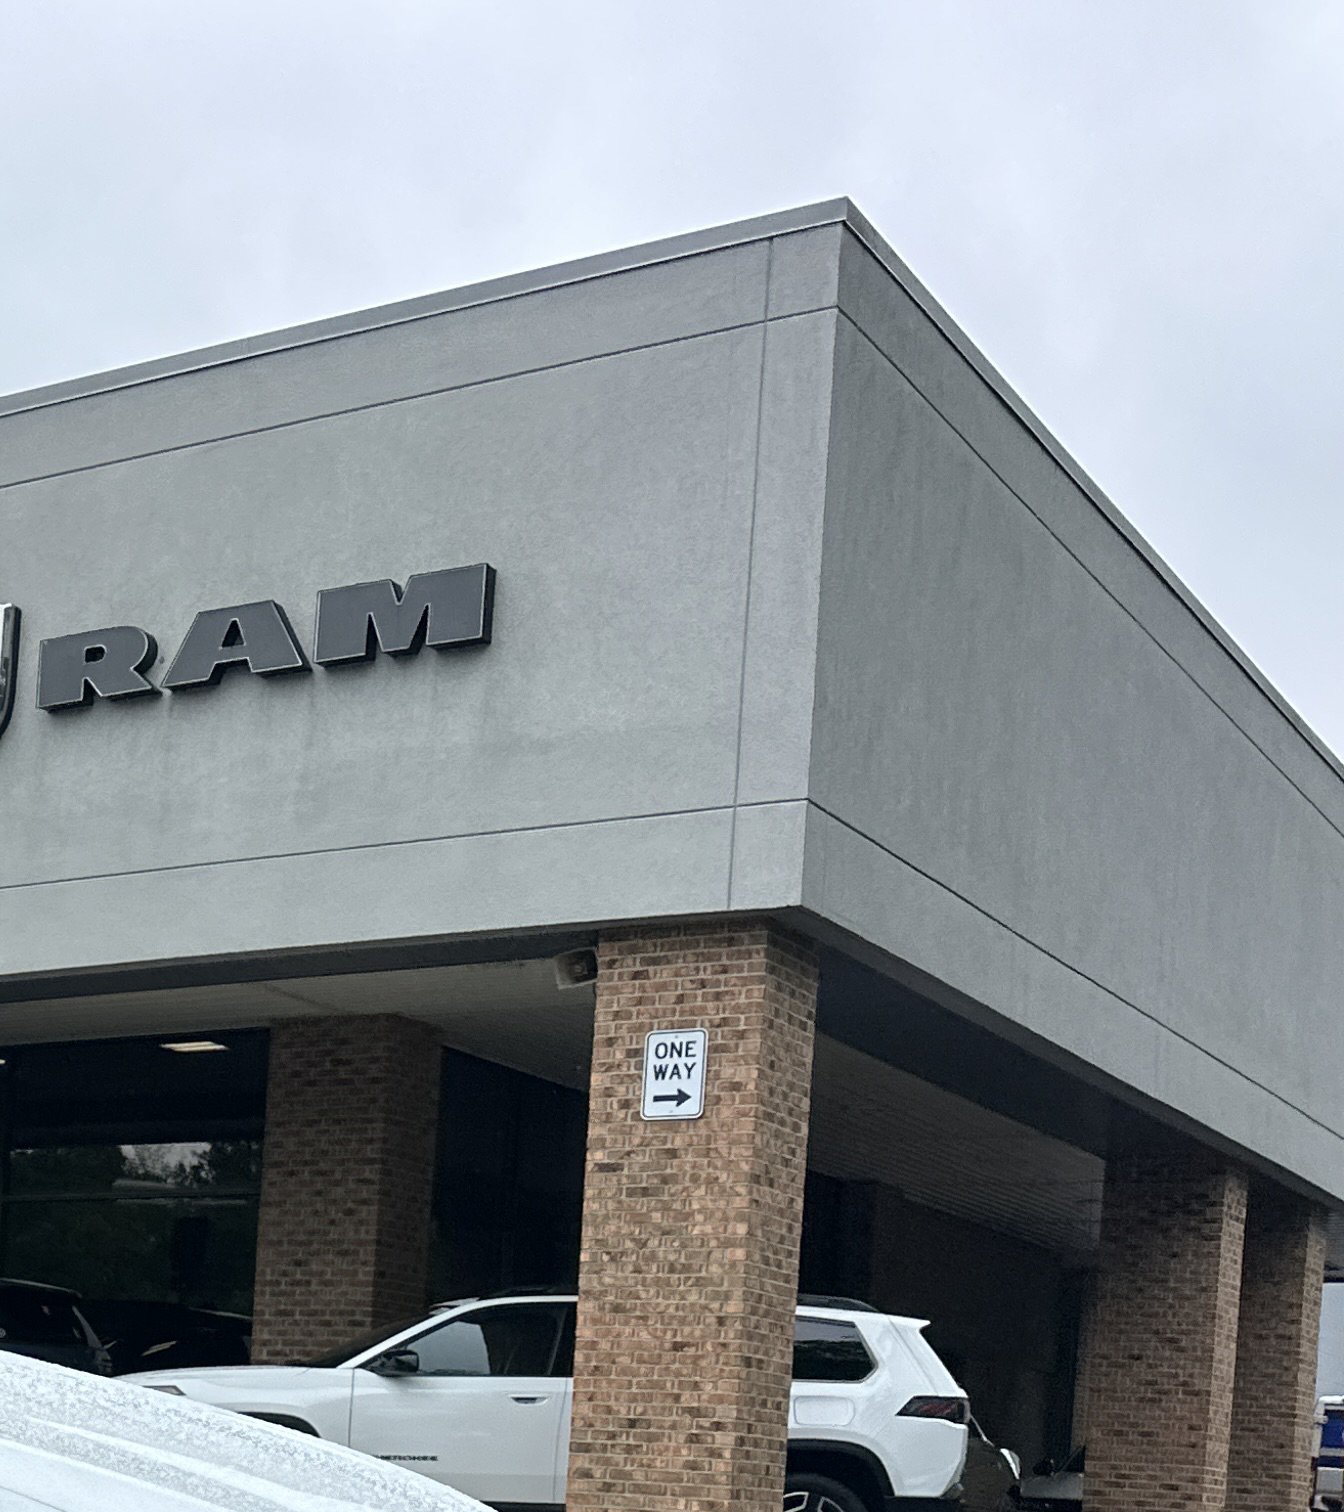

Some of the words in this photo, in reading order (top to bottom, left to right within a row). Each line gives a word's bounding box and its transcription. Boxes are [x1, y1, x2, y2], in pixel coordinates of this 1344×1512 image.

[35, 563, 497, 713] RAM
[654, 1040, 698, 1060] ONE
[653, 1062, 697, 1081] WAY
